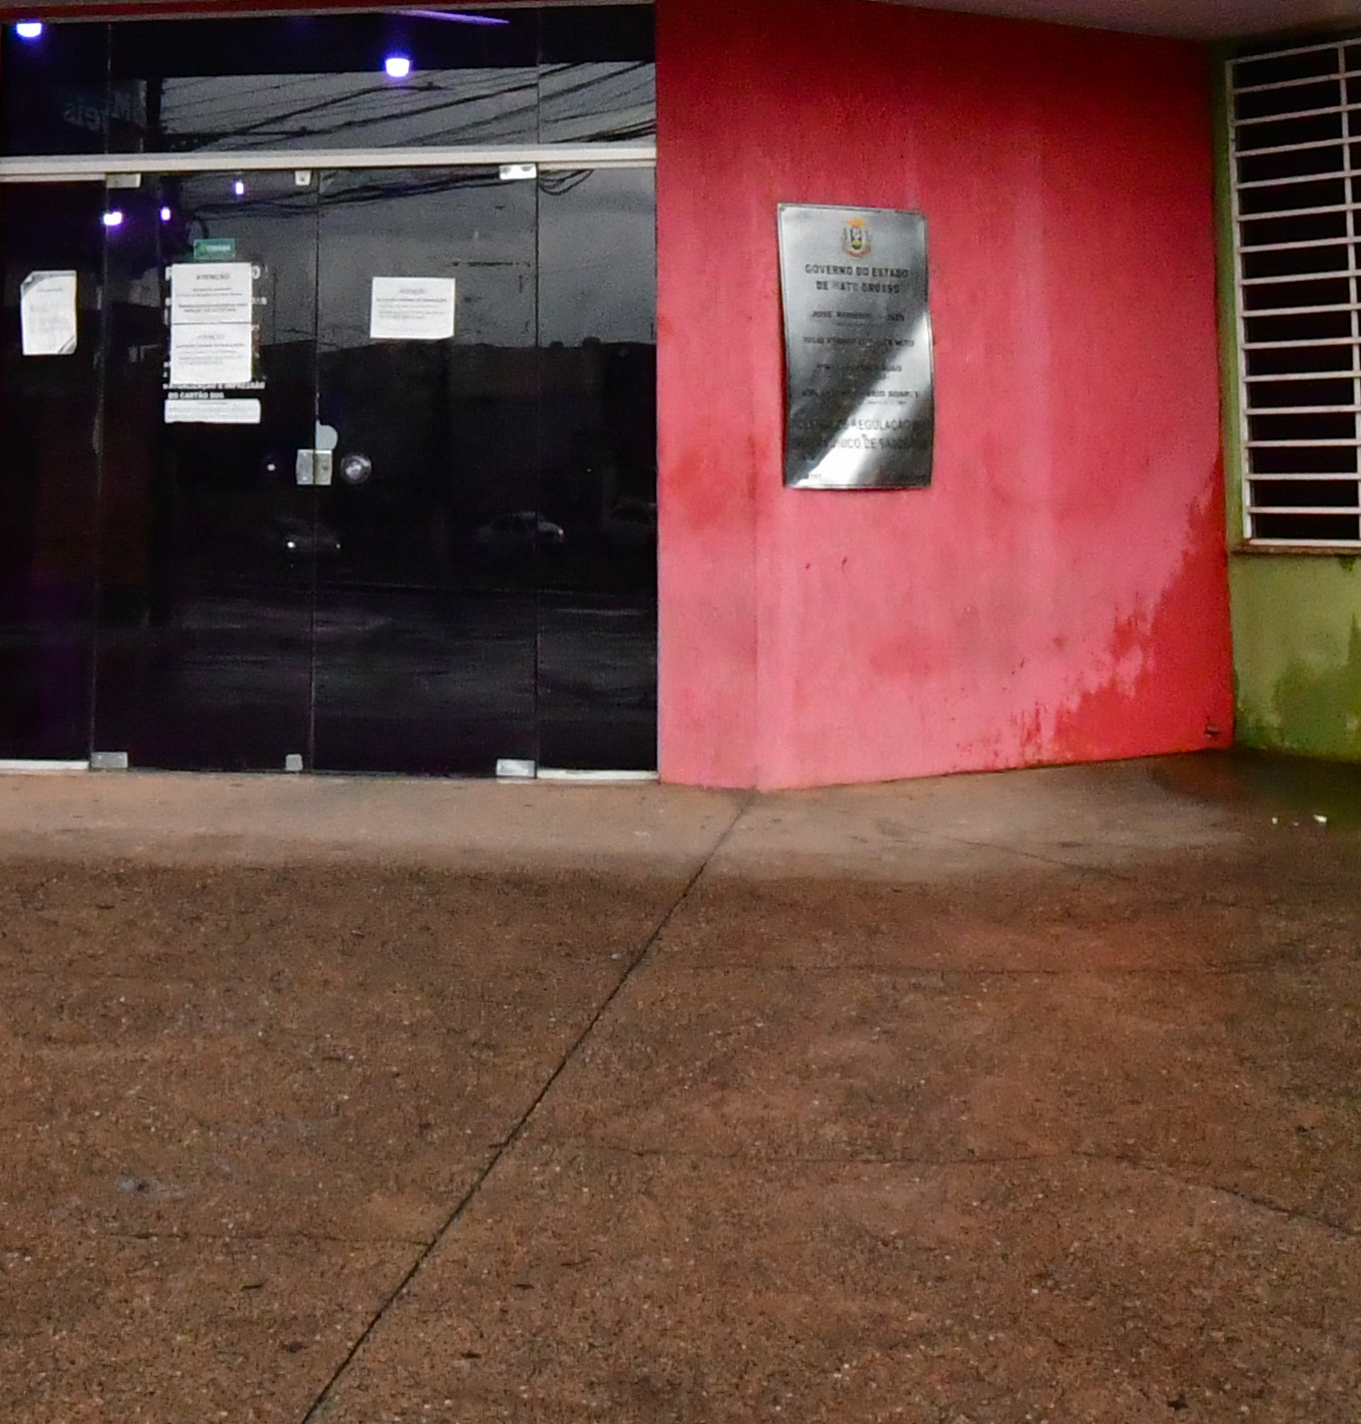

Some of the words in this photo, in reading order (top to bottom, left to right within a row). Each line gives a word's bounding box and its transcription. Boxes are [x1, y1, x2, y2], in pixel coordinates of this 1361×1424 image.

[804, 263, 853, 276] GOVERNO
[855, 265, 869, 277] DO
[871, 267, 910, 279] ESTADO
[816, 280, 829, 291] DE
